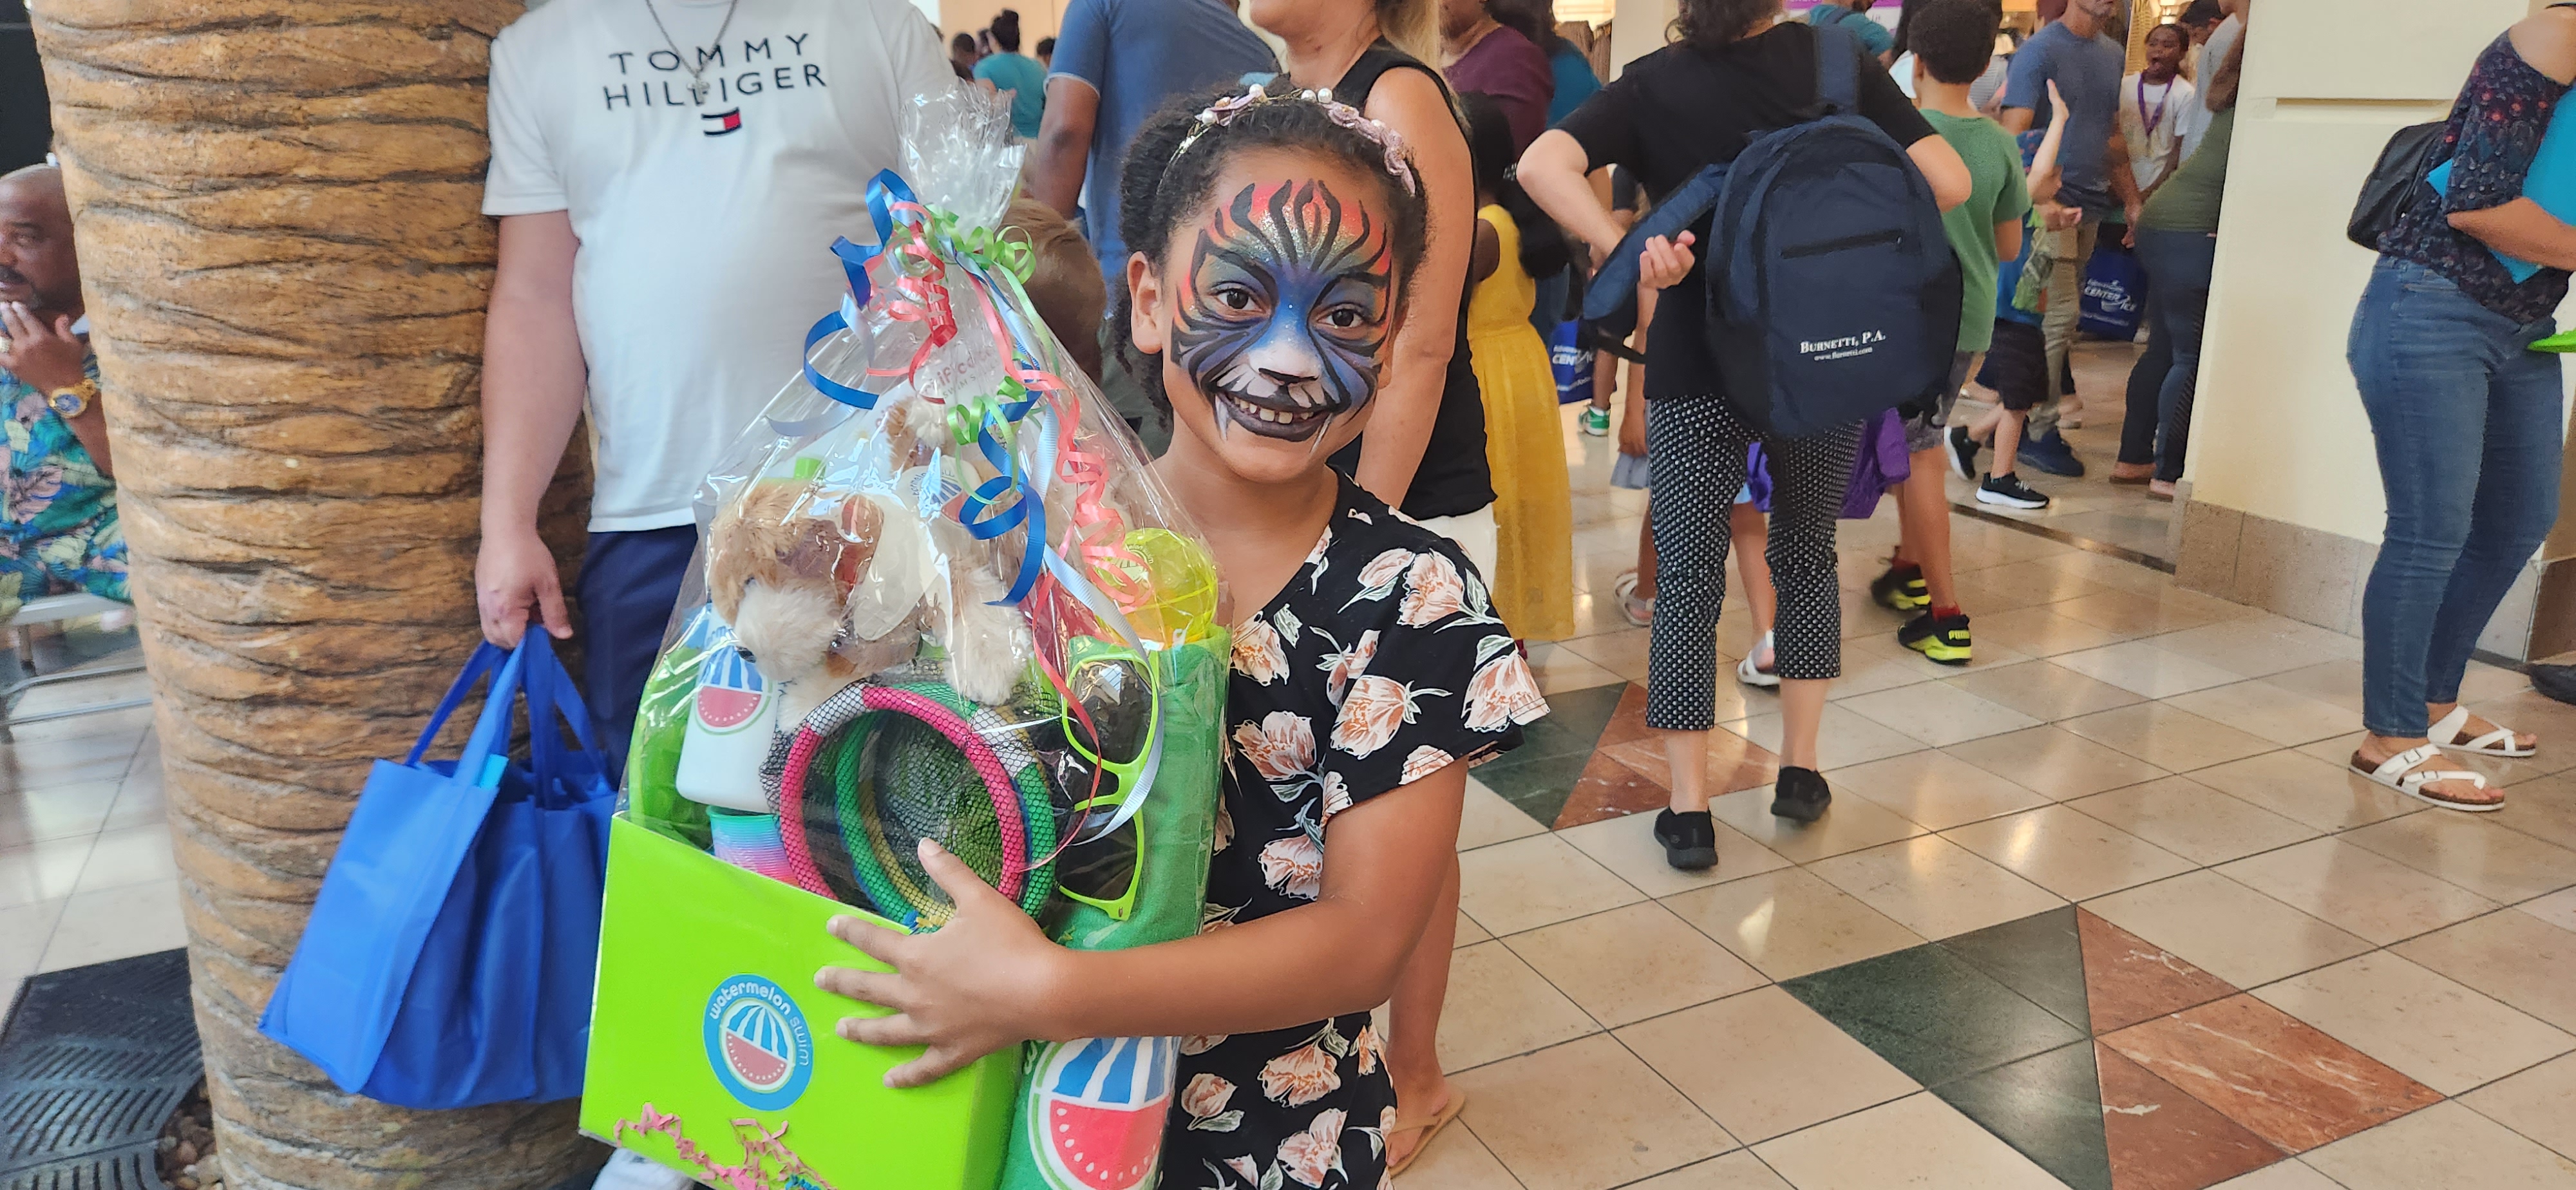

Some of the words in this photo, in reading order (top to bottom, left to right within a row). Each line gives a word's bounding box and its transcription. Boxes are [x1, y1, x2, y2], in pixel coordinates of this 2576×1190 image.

[609, 33, 809, 75] TOMMY
[1862, 330, 1886, 344] P.A.
[709, 981, 791, 1020] watermelon
[790, 1016, 809, 1066] swim
